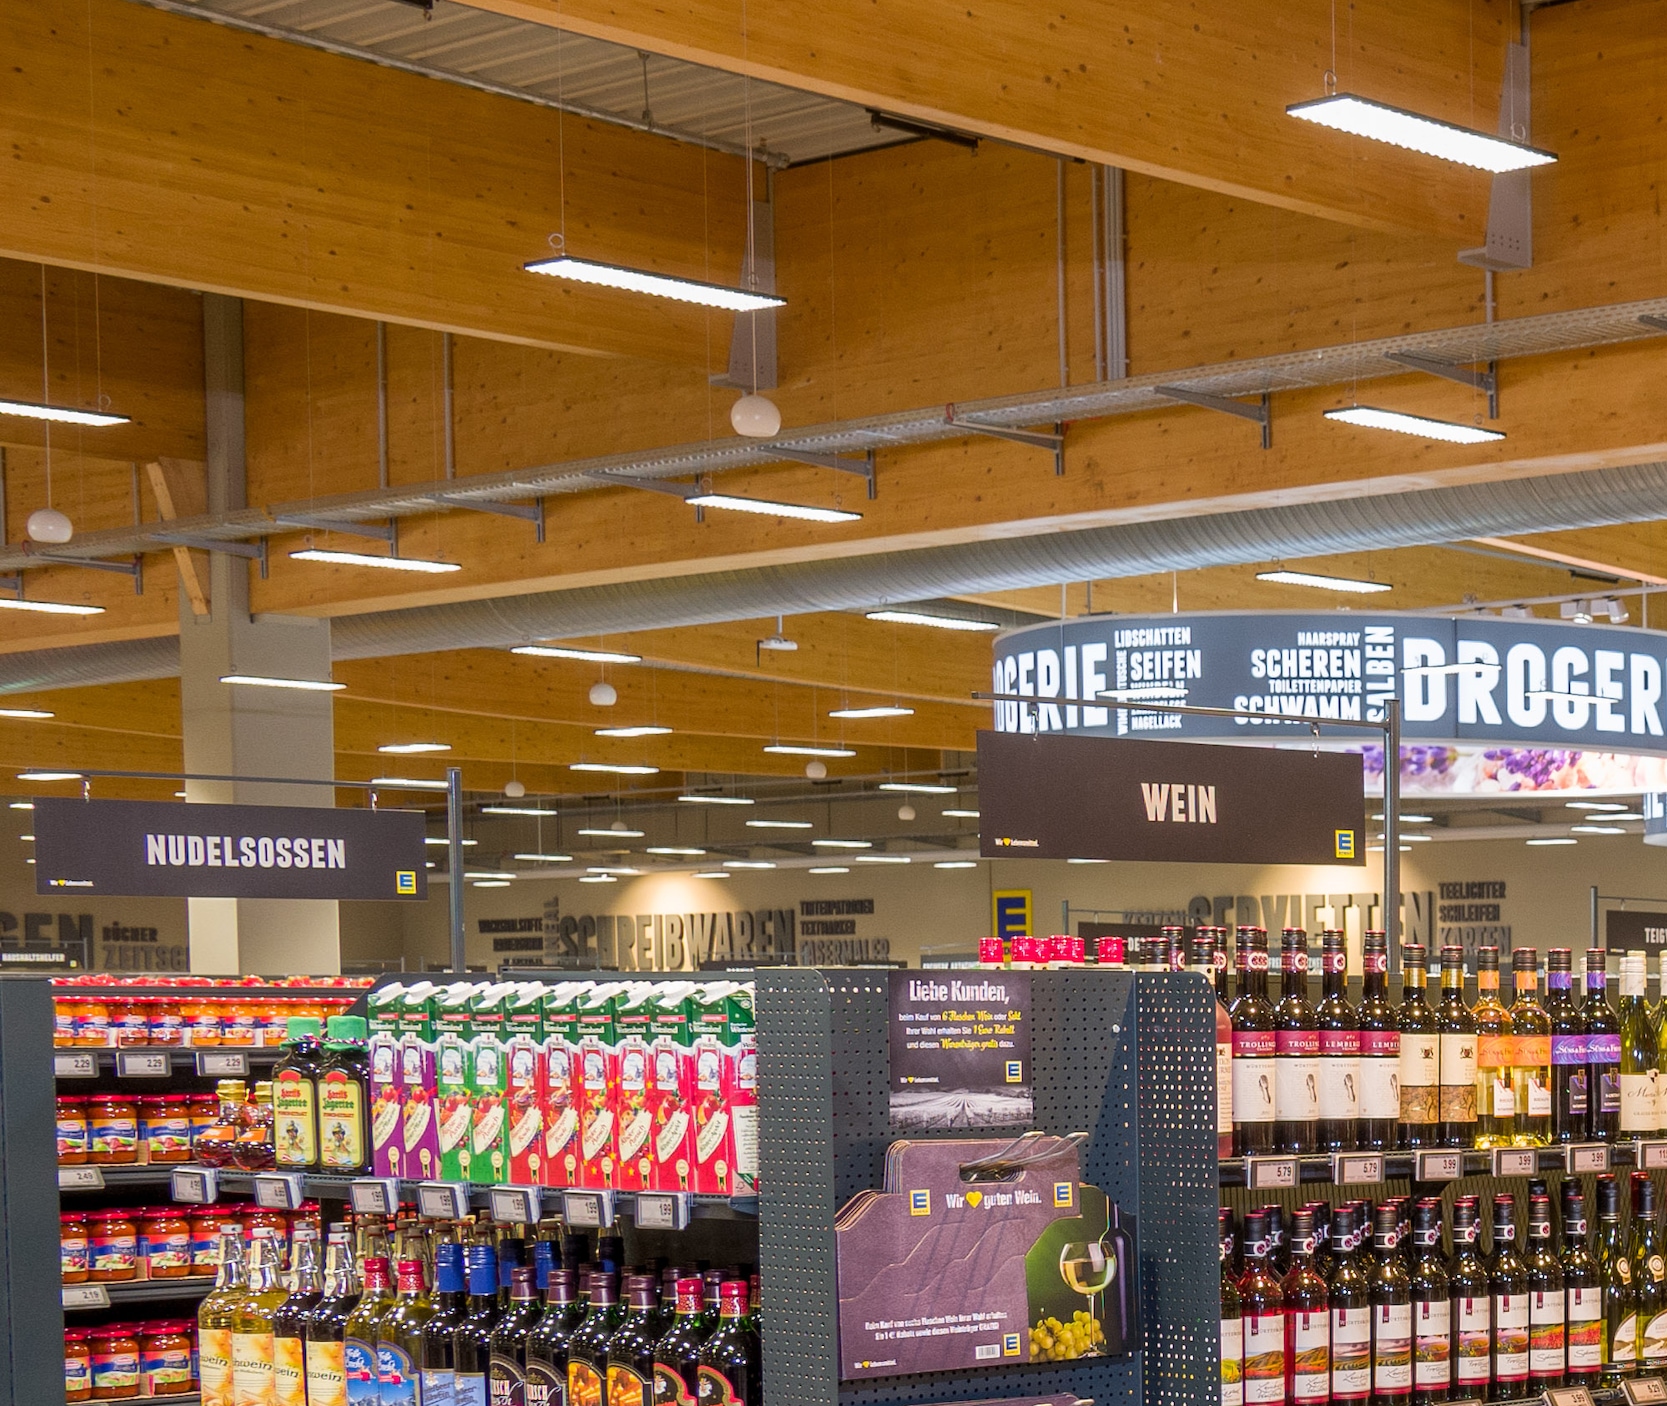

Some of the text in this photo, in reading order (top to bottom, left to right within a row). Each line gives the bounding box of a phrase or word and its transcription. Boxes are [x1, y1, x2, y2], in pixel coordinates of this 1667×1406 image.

[1114, 627, 1190, 648] LIDSCHATTEN
[1298, 632, 1360, 646] HAARSPRAY
[1131, 650, 1200, 680] SEIFEN
[1251, 649, 1361, 678] SCHEREN
[1365, 626, 1394, 723] SALBEN
[1269, 679, 1362, 694] TOILETTENPAPIER
[1234, 696, 1361, 725] SCHWAMM
[1141, 783, 1217, 824] WEIN
[146, 834, 345, 868] NUDELSOSSEN
[1438, 881, 1506, 900] TEELICHTER
[1439, 904, 1500, 922] SCHLEIFEN
[1441, 926, 1511, 956] KARTEN
[909, 980, 1009, 1004] Liebe Kunden,
[946, 1190, 1042, 1209] Wir guten Wein.
